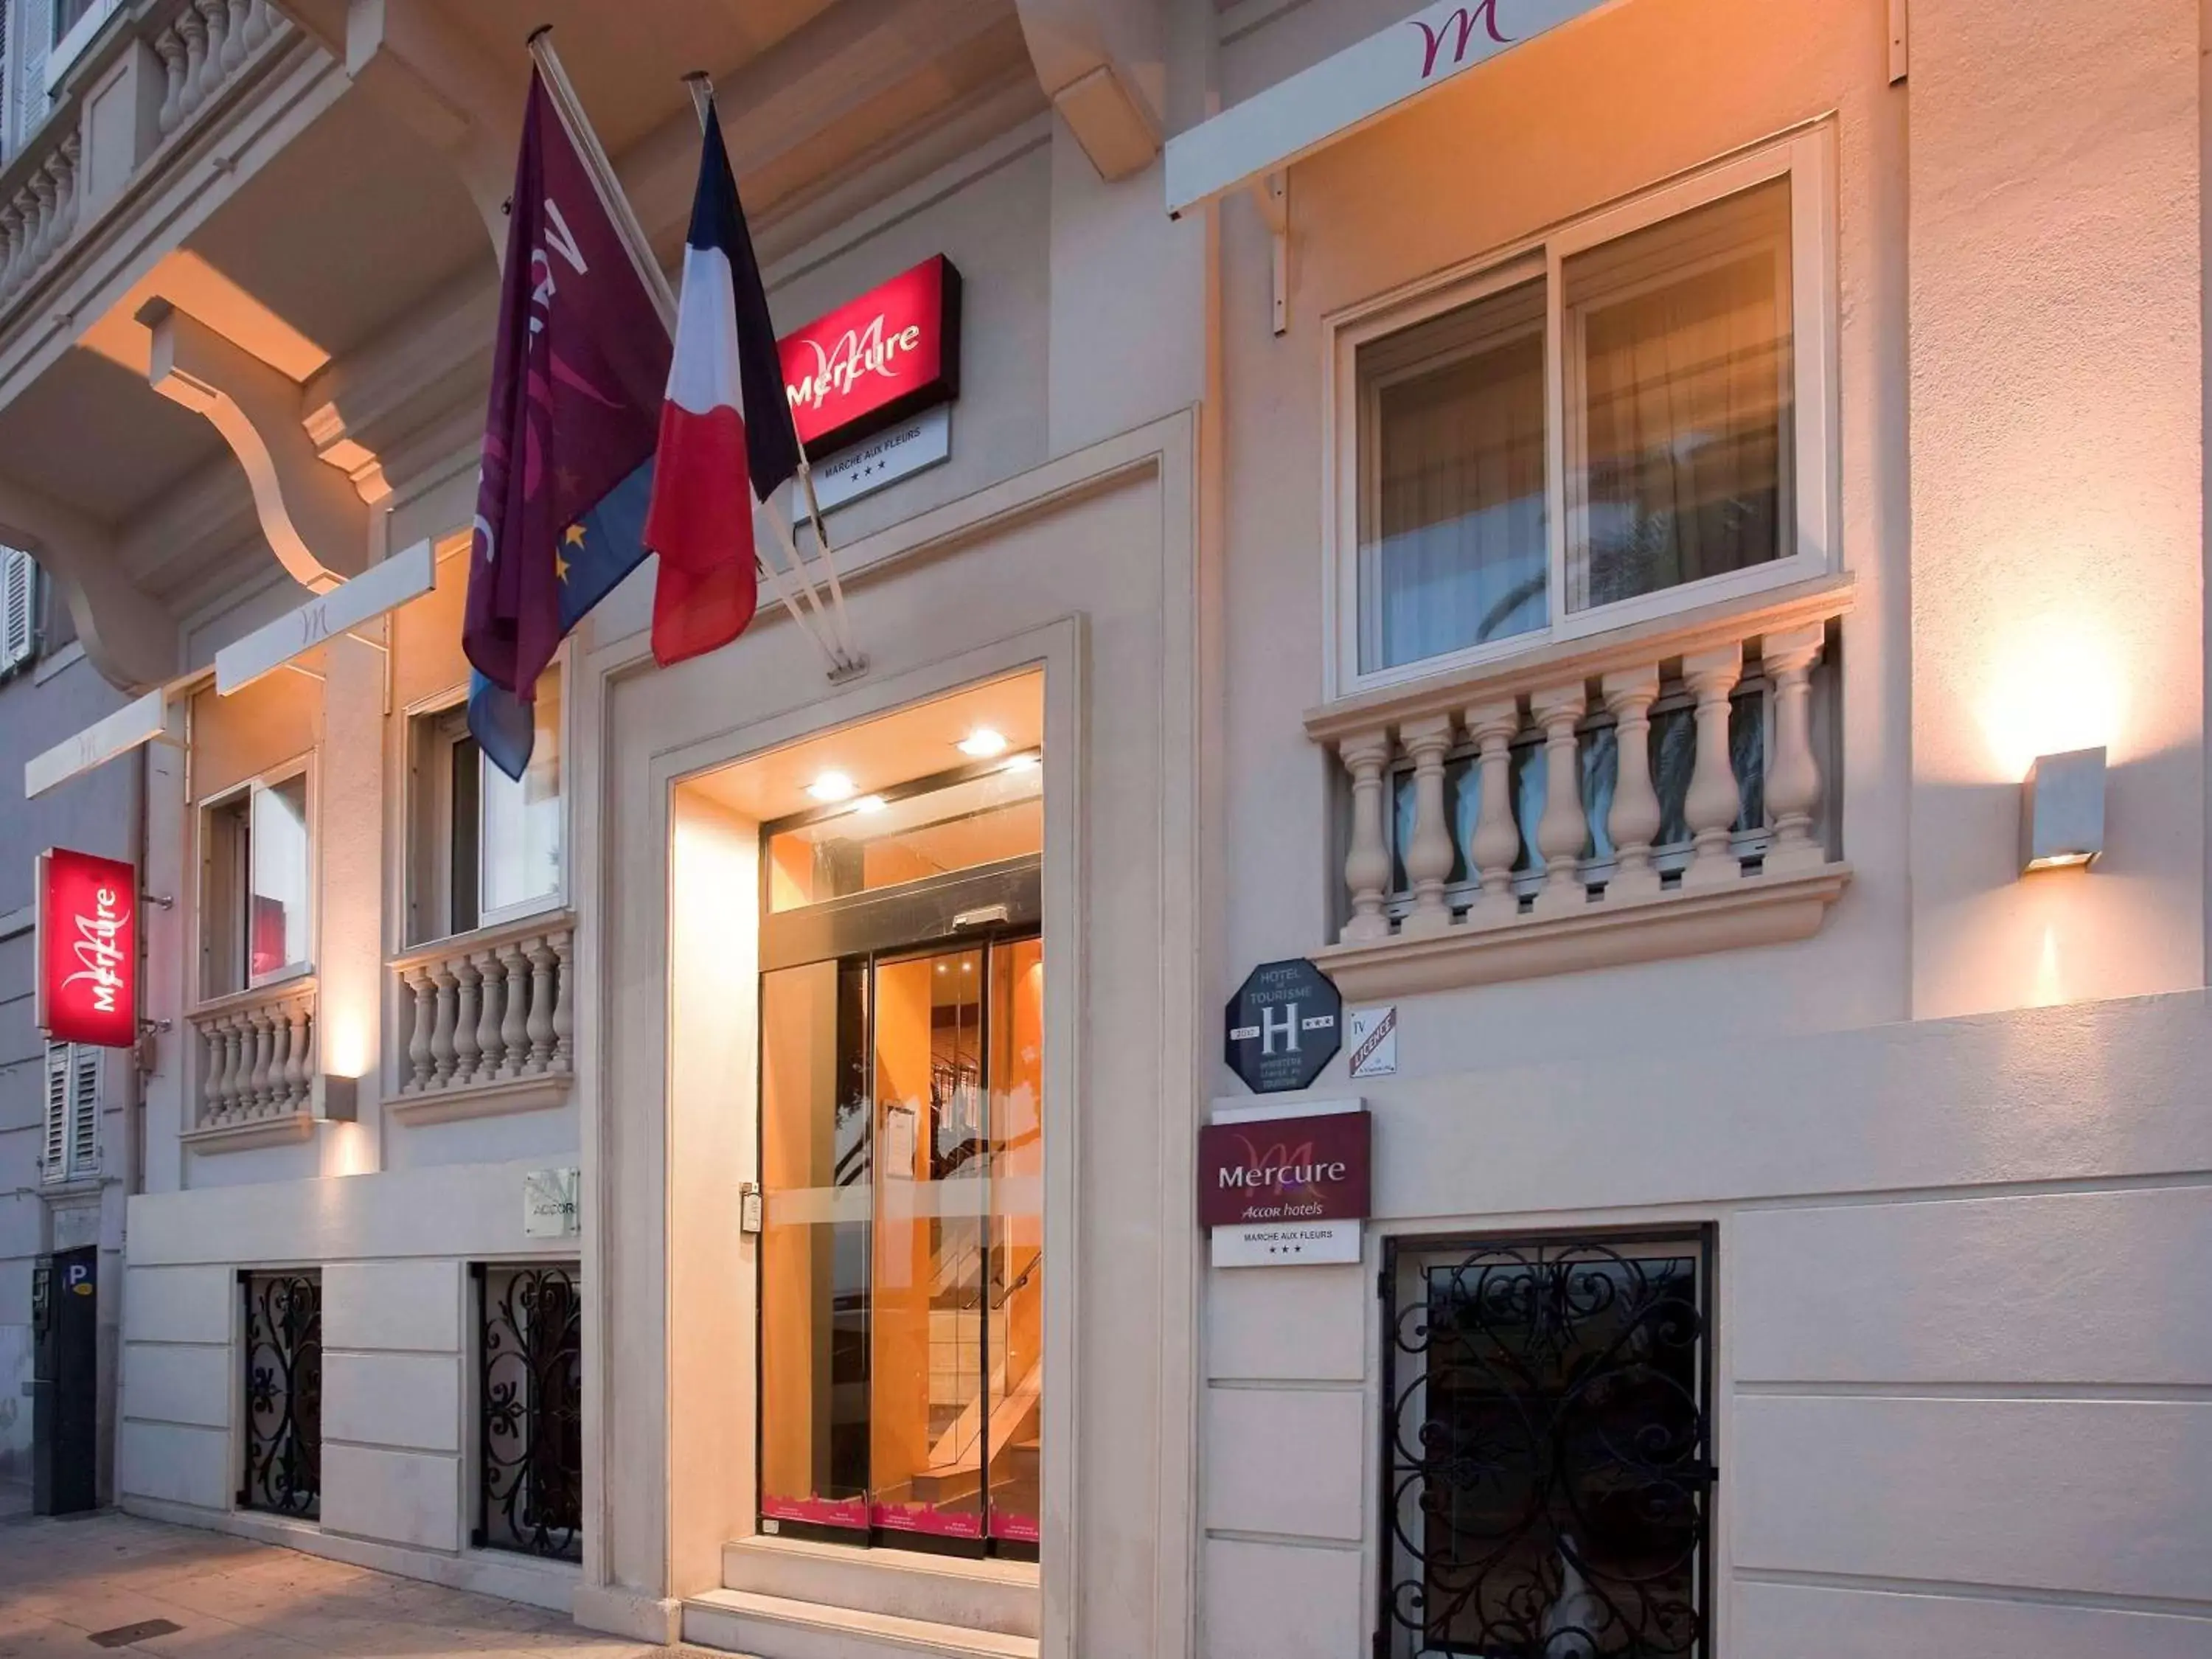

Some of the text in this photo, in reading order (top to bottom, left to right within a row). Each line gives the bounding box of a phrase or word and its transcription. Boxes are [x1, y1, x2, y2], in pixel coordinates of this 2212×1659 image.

[786, 325, 919, 407] Mercure
[824, 427, 921, 478] MARCHE AUX FLEURS
[91, 888, 116, 1012] Mercure
[1260, 968, 1302, 984] HOTEL
[1251, 986, 1312, 1004] TOURISME
[1262, 1003, 1302, 1055] H
[1354, 1016, 1391, 1067] LICENCE
[1219, 1161, 1346, 1189] Mercure
[1284, 1201, 1324, 1217] hotels
[1244, 1232, 1279, 1242] MARCHE
[1300, 1231, 1333, 1239] FLEURS
[70, 1265, 87, 1284] P
